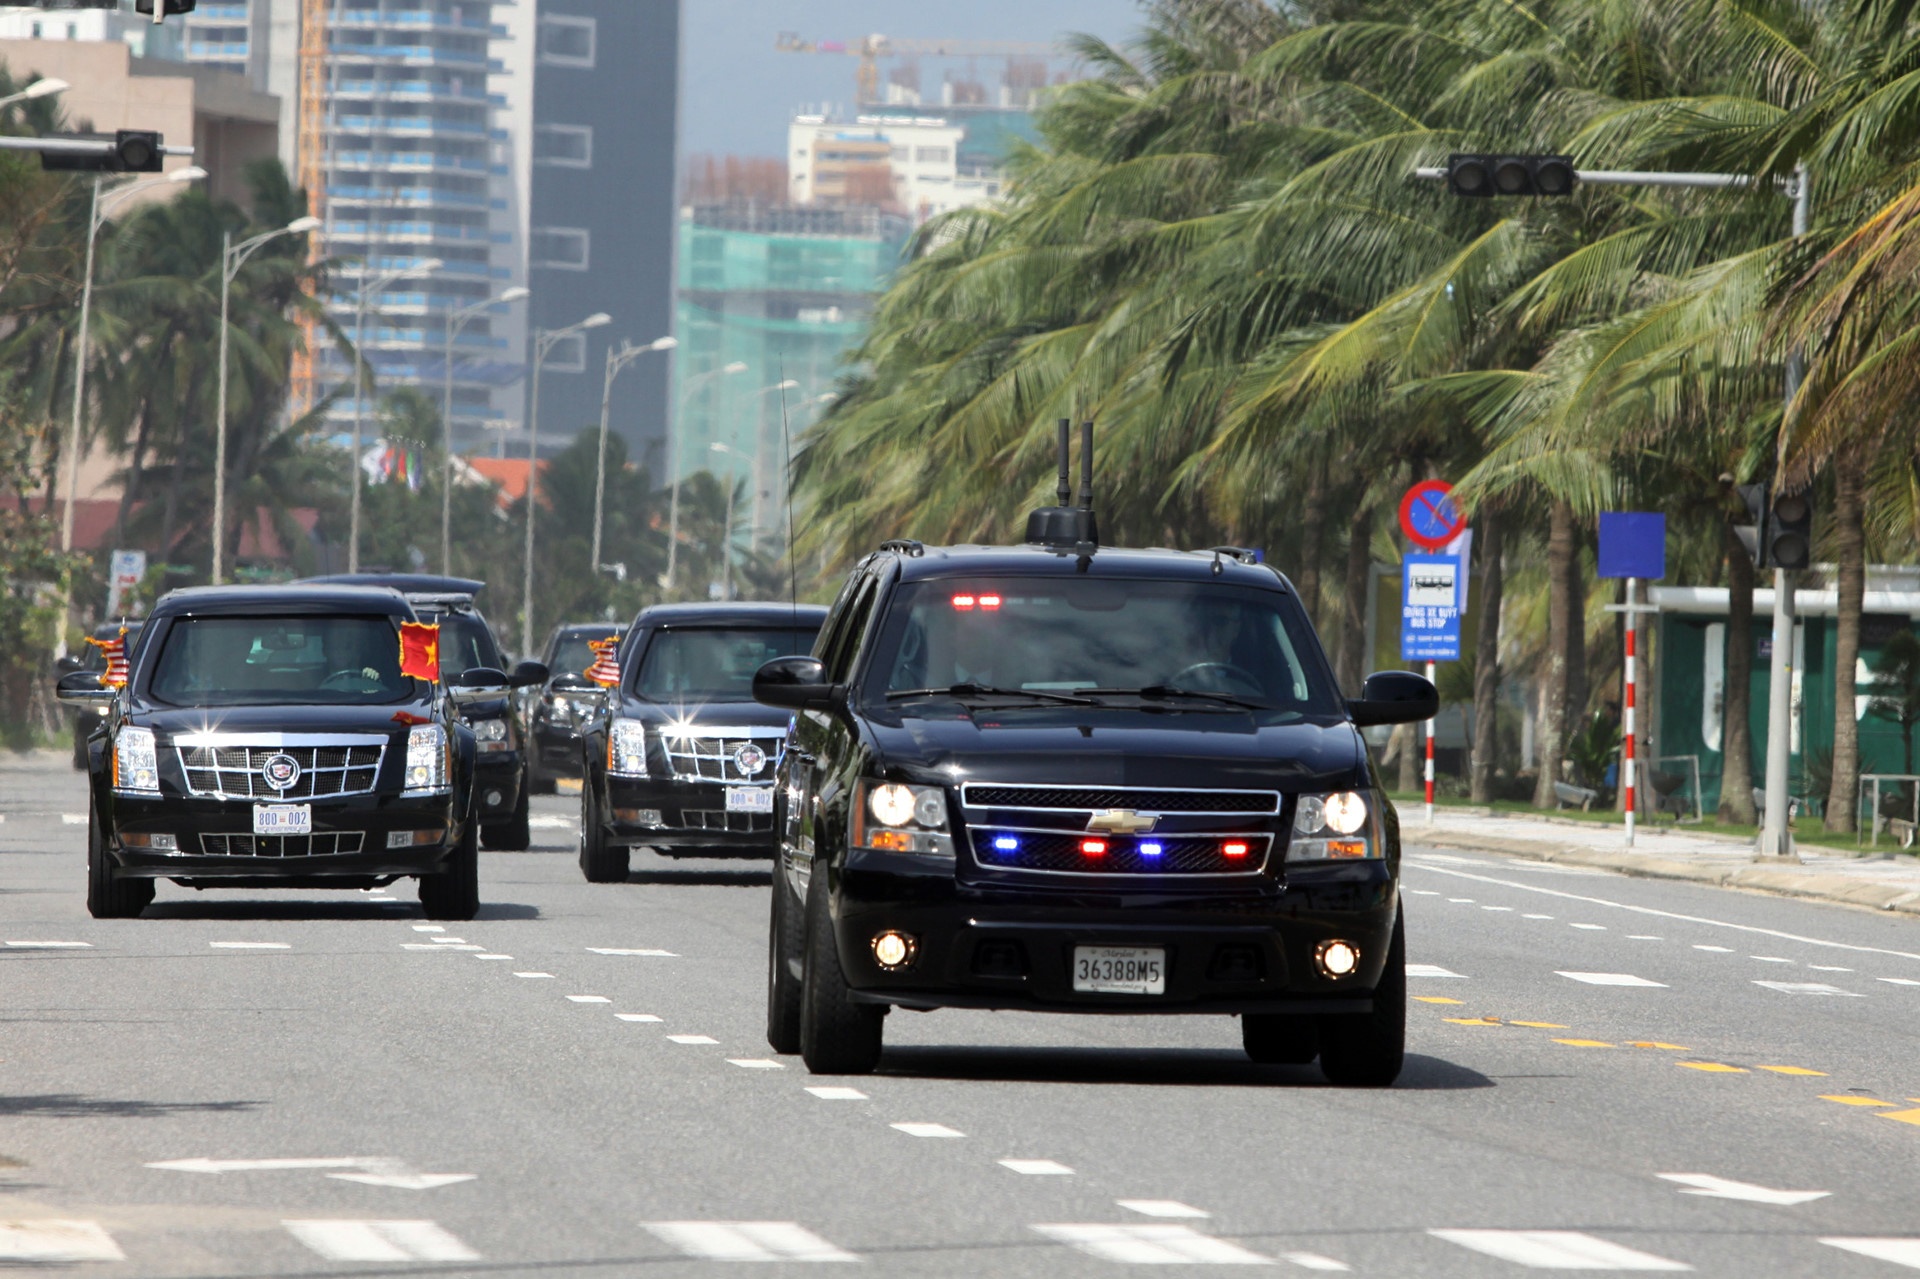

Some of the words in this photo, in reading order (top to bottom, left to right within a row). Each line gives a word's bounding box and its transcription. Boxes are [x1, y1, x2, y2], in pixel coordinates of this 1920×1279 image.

[1411, 618, 1426, 628] BUS
[1427, 618, 1446, 629] STOP
[259, 812, 277, 825] 800
[288, 811, 307, 825] 002
[1079, 959, 1159, 983] 36388M5
